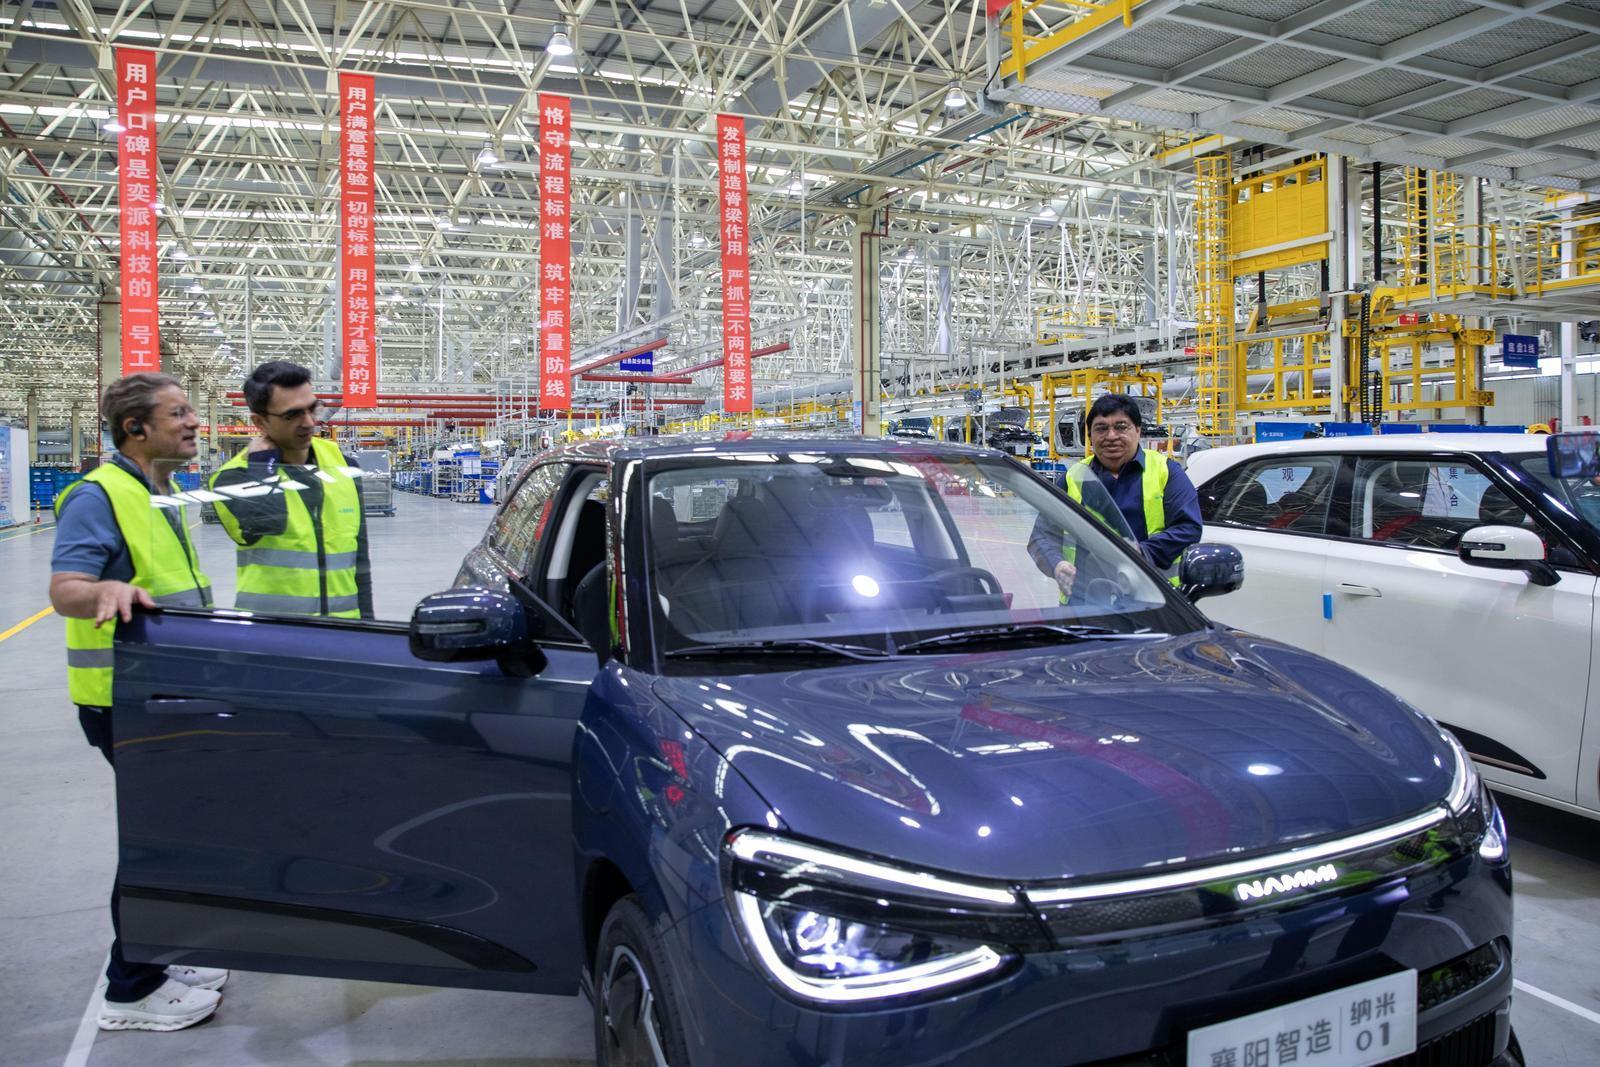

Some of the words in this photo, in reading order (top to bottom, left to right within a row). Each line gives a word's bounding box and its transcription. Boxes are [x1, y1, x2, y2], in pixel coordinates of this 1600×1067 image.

[346, 86, 369, 257] 用户满意是检验一切的标准
[544, 106, 565, 240] 恪守流程标准
[723, 126, 743, 256] 发挥制造脊梁作用
[348, 268, 370, 395] 用户说好才是真的好
[544, 263, 565, 397] 筑牢质量防线
[726, 269, 746, 400] 严抓三不两保要求
[1237, 863, 1338, 900] NAMMI
[1210, 1018, 1332, 1067] 襄阳智造
[1350, 992, 1396, 1026] 纳米
